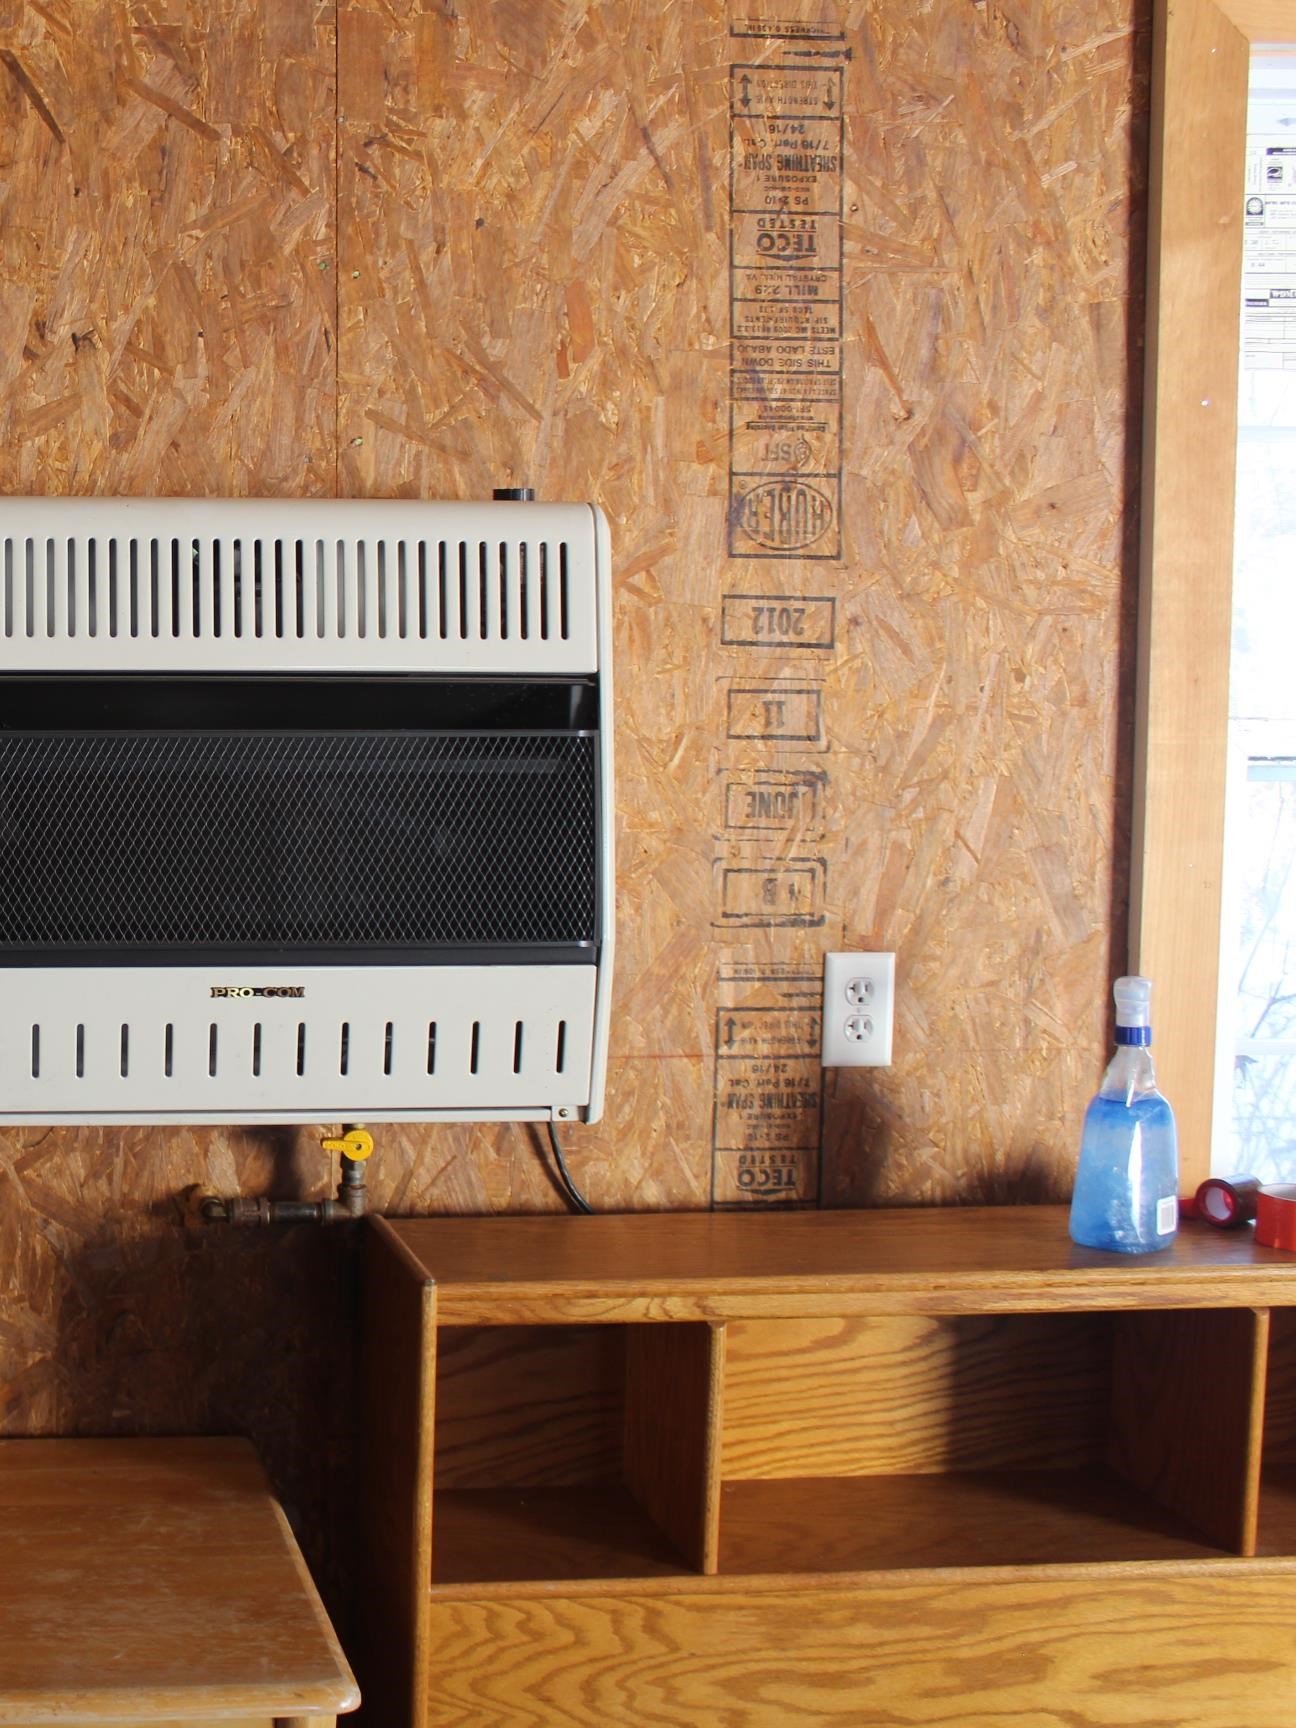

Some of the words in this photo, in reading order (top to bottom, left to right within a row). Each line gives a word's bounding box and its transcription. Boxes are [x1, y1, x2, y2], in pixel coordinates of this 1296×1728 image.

[768, 123, 806, 134] 24/16
[743, 153, 773, 171] SPAN
[776, 155, 837, 172] SHEATHING
[764, 175, 818, 183] EXPOSURE
[794, 196, 809, 206] PS
[757, 218, 817, 229] TESTED
[757, 233, 817, 253] TECO
[787, 274, 828, 282] CRYSTAL
[784, 285, 819, 296] MILL
[737, 345, 772, 354] ABAJO
[775, 345, 805, 355] LADO
[808, 346, 835, 355] ESTE
[741, 357, 774, 367] DOWN
[778, 358, 803, 368] SIDE
[807, 358, 831, 368] THIS
[751, 607, 806, 636] 2012
[744, 791, 800, 819] JUNE
[210, 987, 305, 998] PRO-COM
[751, 1064, 788, 1074] 24/16
[738, 1155, 796, 1164] TESTED
[737, 1169, 796, 1187] TECO
